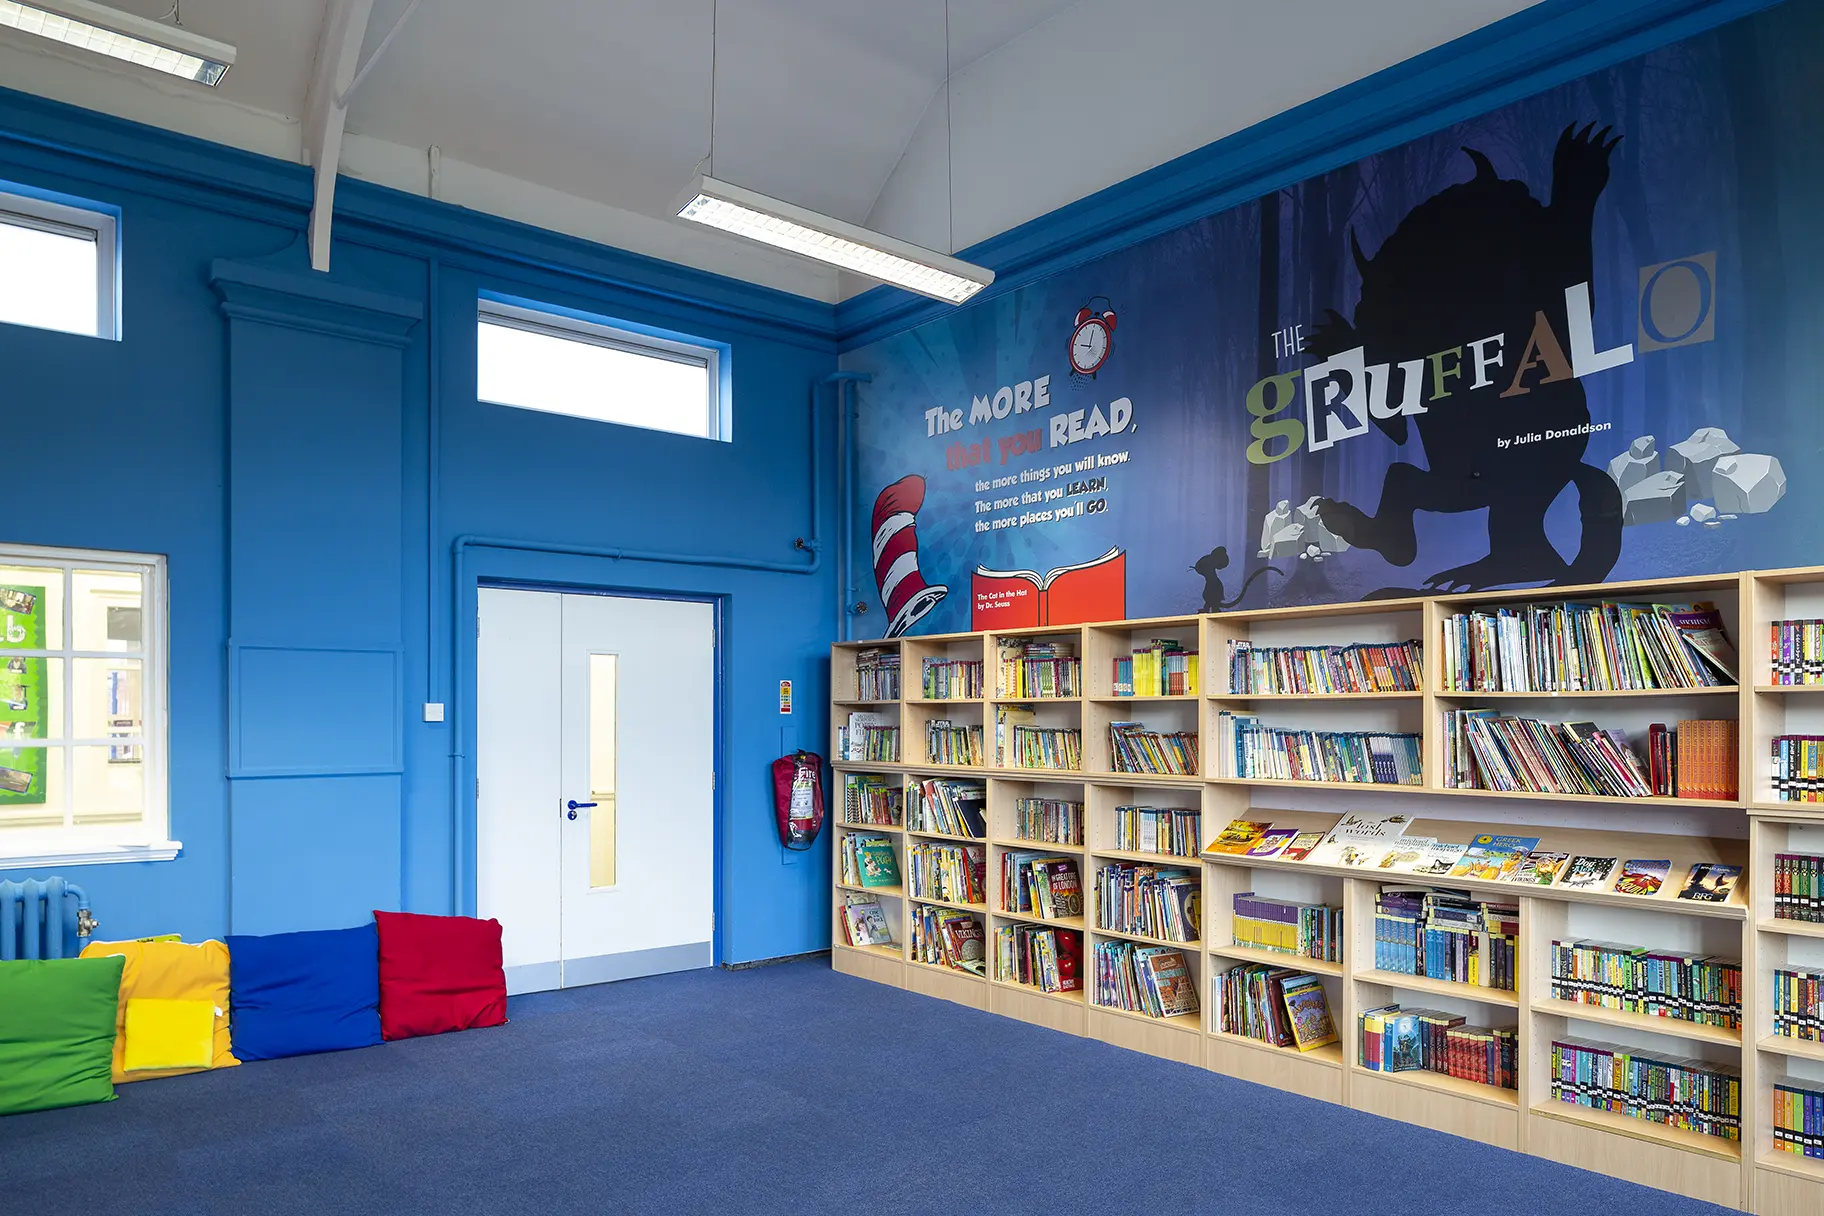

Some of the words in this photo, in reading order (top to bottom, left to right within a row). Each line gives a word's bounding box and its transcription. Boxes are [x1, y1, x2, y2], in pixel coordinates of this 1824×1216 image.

[1270, 323, 1306, 360] THE
[925, 405, 964, 438] The
[968, 375, 1050, 426] MORE
[945, 435, 992, 471] that
[998, 428, 1043, 466] you
[1049, 397, 1138, 448] READ,
[1497, 438, 1511, 449] by
[1514, 433, 1542, 446] Julia
[1545, 422, 1612, 440] Donaldson
[975, 480, 991, 492] the
[992, 476, 1018, 488] more
[1020, 468, 1051, 483] things
[1053, 464, 1072, 479] you
[1075, 457, 1095, 472] will
[1097, 451, 1131, 468] know.
[975, 500, 992, 513] The
[994, 497, 1019, 510] more
[1021, 490, 1042, 504] that
[1045, 487, 1063, 502] you
[975, 520, 990, 533] the
[992, 516, 1018, 530] more
[1020, 509, 1053, 528] places
[977, 593, 988, 601] The
[988, 592, 998, 600] Cat
[1006, 590, 1015, 598] the
[1016, 589, 1027, 597] Hat
[977, 603, 984, 611] by
